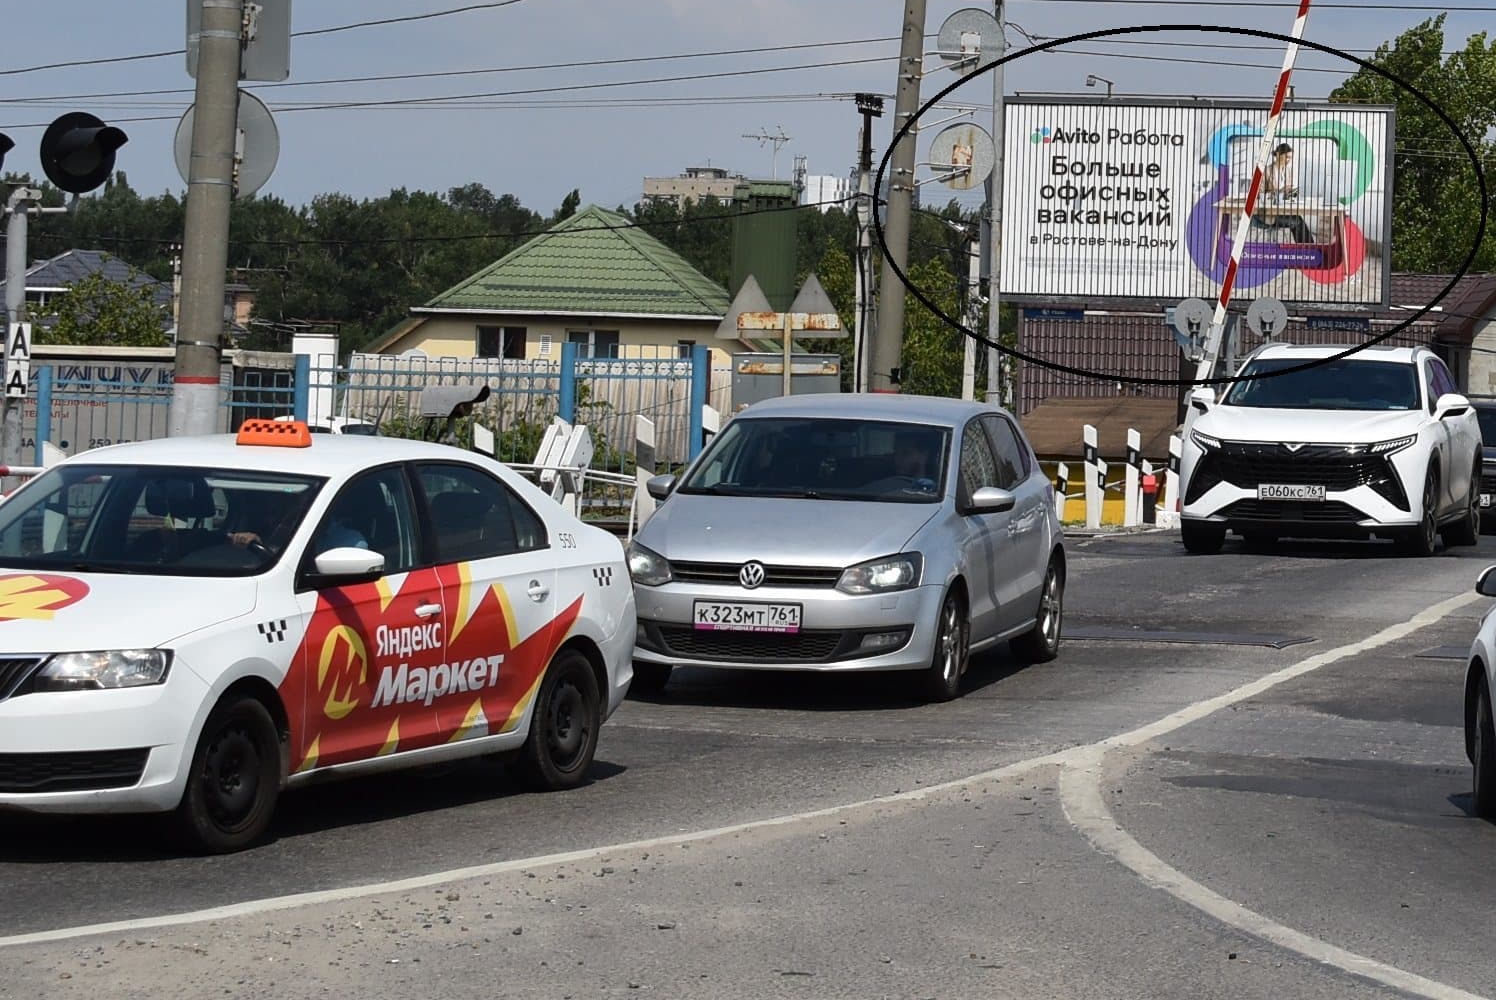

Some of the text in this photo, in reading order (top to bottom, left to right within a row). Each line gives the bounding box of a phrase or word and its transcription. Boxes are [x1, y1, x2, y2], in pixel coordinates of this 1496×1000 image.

[1051, 127, 1185, 147] Avito Работа
[1051, 155, 1161, 178] Больше
[1039, 179, 1171, 206] офисных
[1037, 201, 1171, 227] вакансий
[1030, 233, 1179, 251] в Ростове-на-Дону
[11, 325, 28, 357] А
[6, 370, 28, 395] Д
[1261, 486, 1323, 498] Е060КС 761
[699, 605, 796, 625] К323МТ 761
[376, 622, 442, 659] Яндекс
[370, 654, 505, 708] Маркет
